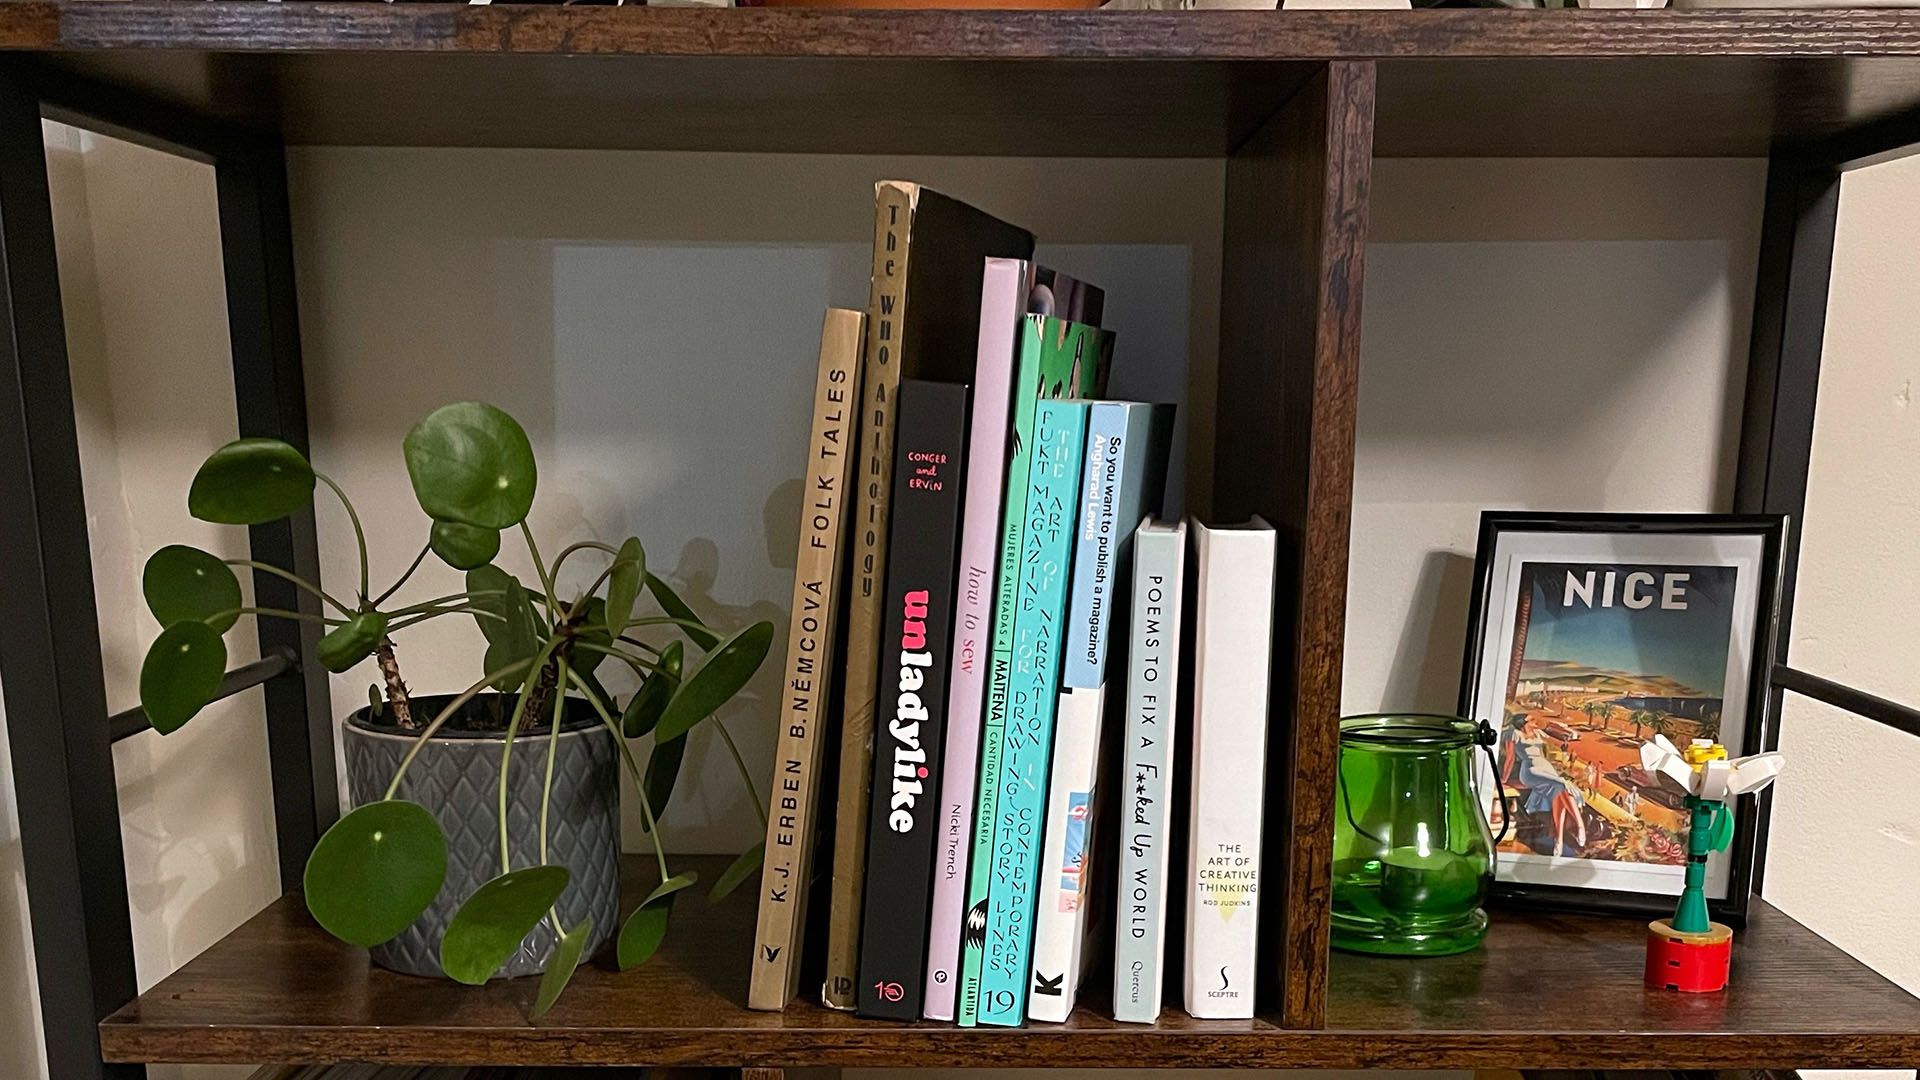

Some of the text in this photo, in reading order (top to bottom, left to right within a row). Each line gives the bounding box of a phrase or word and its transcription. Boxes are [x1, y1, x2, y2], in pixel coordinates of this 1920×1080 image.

[885, 204, 899, 276] The
[821, 369, 846, 459] TALES
[1036, 410, 1054, 475] FUKT
[908, 451, 947, 465] CONGER
[916, 465, 937, 477] and
[1054, 429, 1070, 478] THE
[811, 476, 834, 548] FOLK
[1085, 434, 1107, 541] Angharad Lewis
[1005, 524, 1017, 571] MUJERES
[1023, 485, 1049, 612] MAGAZINE
[1047, 496, 1062, 543] ART
[1043, 560, 1058, 591] OF
[1087, 436, 1122, 665] So you want to publish a magazine?
[961, 566, 987, 674] how to sew
[998, 575, 1011, 636] ALTERADAS
[1146, 575, 1163, 648] POEMS
[1562, 569, 1691, 610] NICE
[1017, 629, 1032, 674] FOR
[1028, 609, 1052, 746] NARRATION
[1144, 656, 1158, 682] TO
[889, 590, 933, 833] unladylike
[991, 659, 1009, 721] MAITENA
[1141, 695, 1157, 725] FIX
[1140, 736, 1154, 748] A
[777, 760, 802, 846] ERBEN
[980, 732, 998, 845] CANTIDAD NECESARIA
[946, 804, 962, 880] Nicki Trench
[996, 813, 1015, 884] STORY
[1131, 834, 1153, 858] Up
[1208, 857, 1250, 866] ART OF
[1218, 844, 1241, 853] THE
[1003, 807, 1032, 979] CONTEMPORARY
[1131, 868, 1149, 939] WORLD
[1198, 883, 1257, 892] THINKING
[1200, 870, 1256, 879] CREATIVE
[990, 901, 1008, 971] LINES
[965, 977, 977, 1016] ATLANTIDA
[983, 989, 1015, 1015] 19
[1130, 961, 1143, 1004] Quercus
